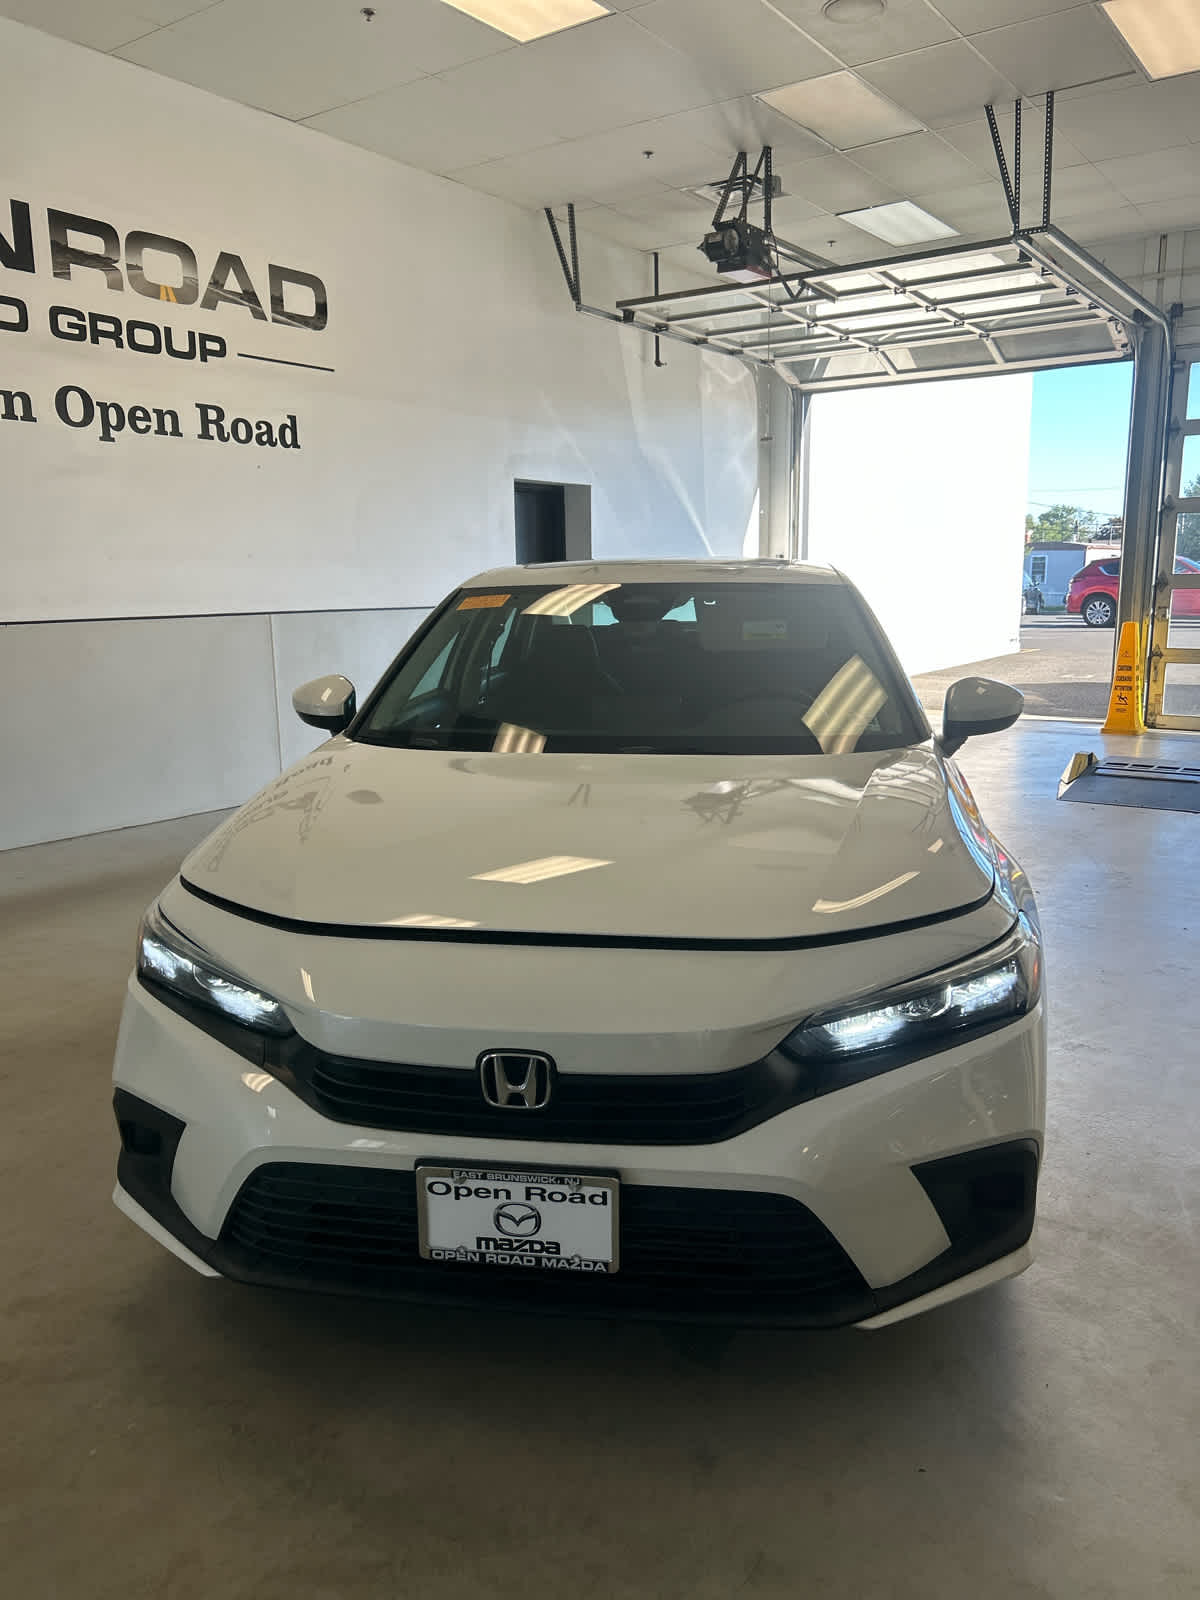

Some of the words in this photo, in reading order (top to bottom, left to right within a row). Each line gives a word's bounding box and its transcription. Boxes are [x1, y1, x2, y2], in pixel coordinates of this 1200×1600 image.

[49, 306, 226, 363] GROUP
[54, 385, 183, 442] Open
[195, 403, 301, 449] Road
[453, 1170, 482, 1180] EAST
[564, 1177, 581, 1186] NJ
[427, 1181, 511, 1200] Open
[525, 1186, 608, 1206] Road
[432, 1250, 480, 1263] OPEN
[485, 1253, 536, 1267] ROAD
[541, 1258, 607, 1273] MAZDA
